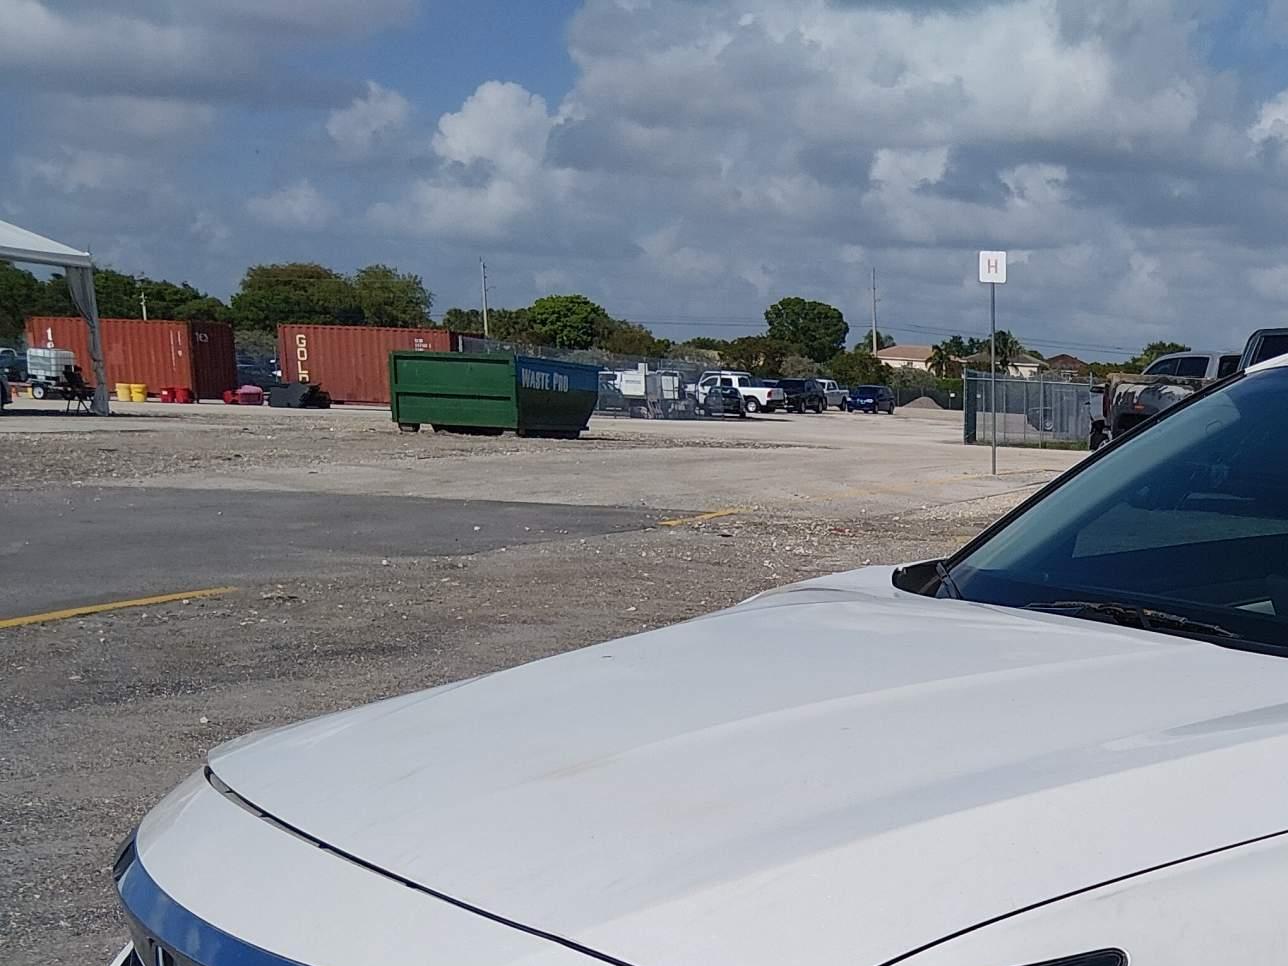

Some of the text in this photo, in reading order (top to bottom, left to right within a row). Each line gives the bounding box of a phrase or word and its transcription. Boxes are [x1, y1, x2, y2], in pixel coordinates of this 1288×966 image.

[987, 259, 998, 274] H
[521, 367, 569, 393] WASTE PRO
